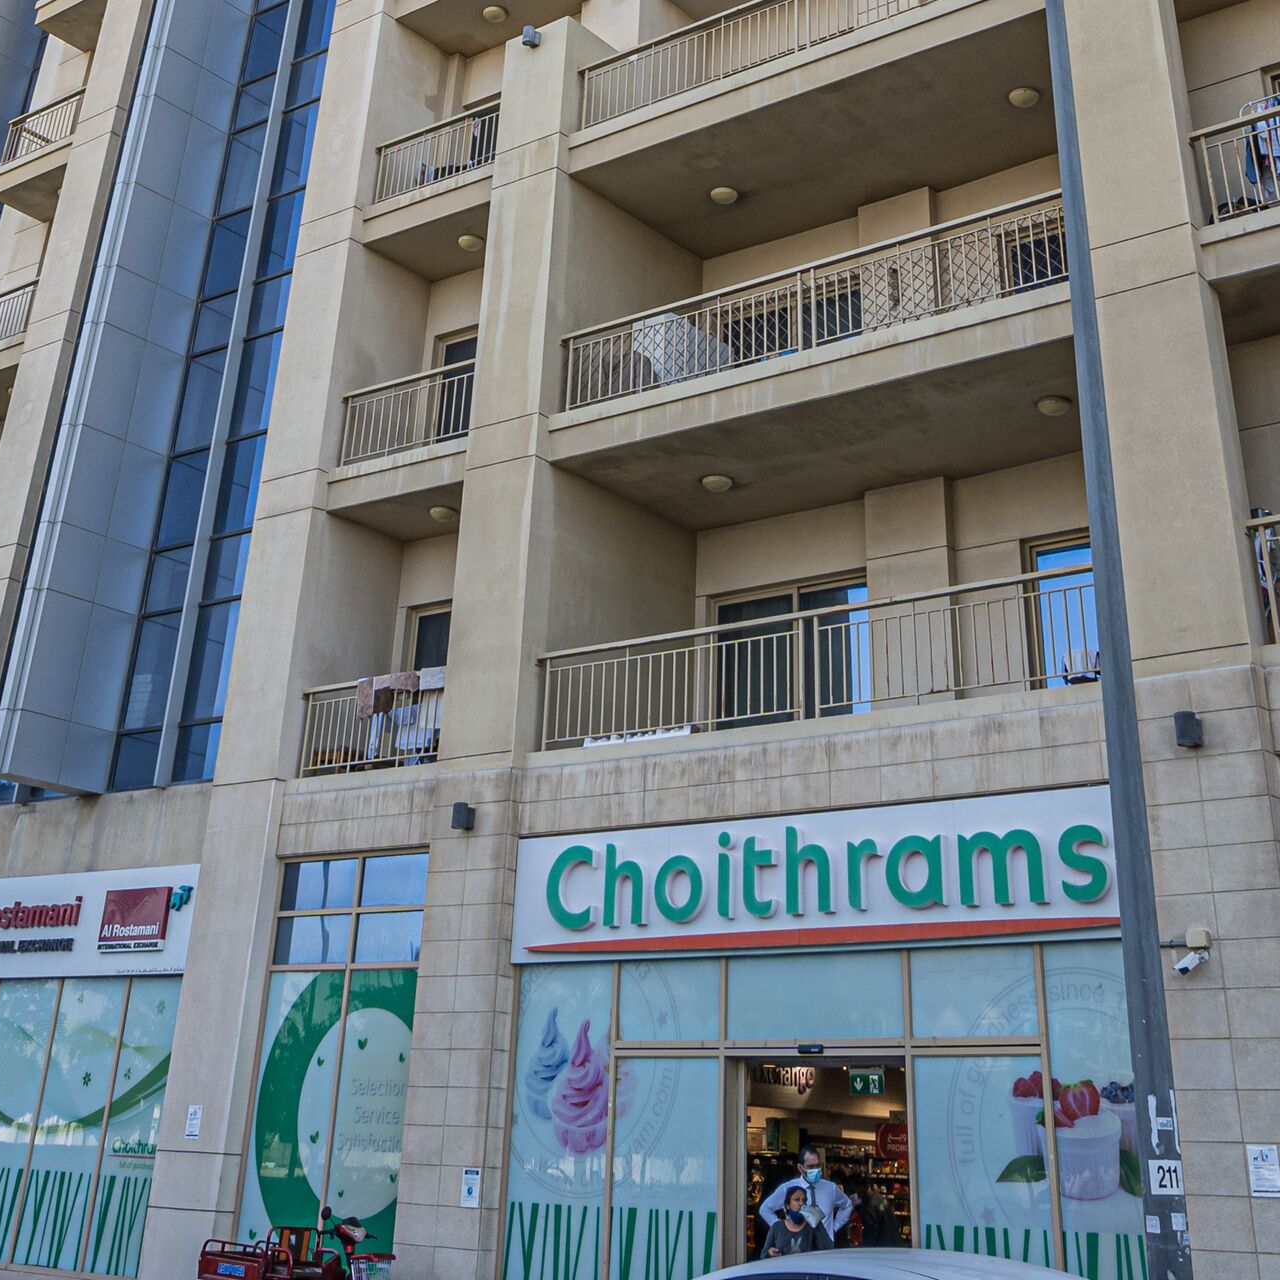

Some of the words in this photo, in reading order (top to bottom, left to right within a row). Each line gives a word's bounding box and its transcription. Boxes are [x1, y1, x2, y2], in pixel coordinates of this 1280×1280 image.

[546, 824, 1114, 931] Choithrams
[101, 924, 114, 938] Al
[113, 922, 159, 937] Rostamani
[97, 943, 133, 951] INTERNATIONAL
[133, 941, 159, 950] EXCHANGE
[959, 1087, 976, 1114] of
[352, 1103, 401, 1125] Service
[955, 1125, 977, 1166] full
[1157, 1165, 1180, 1189] 211
